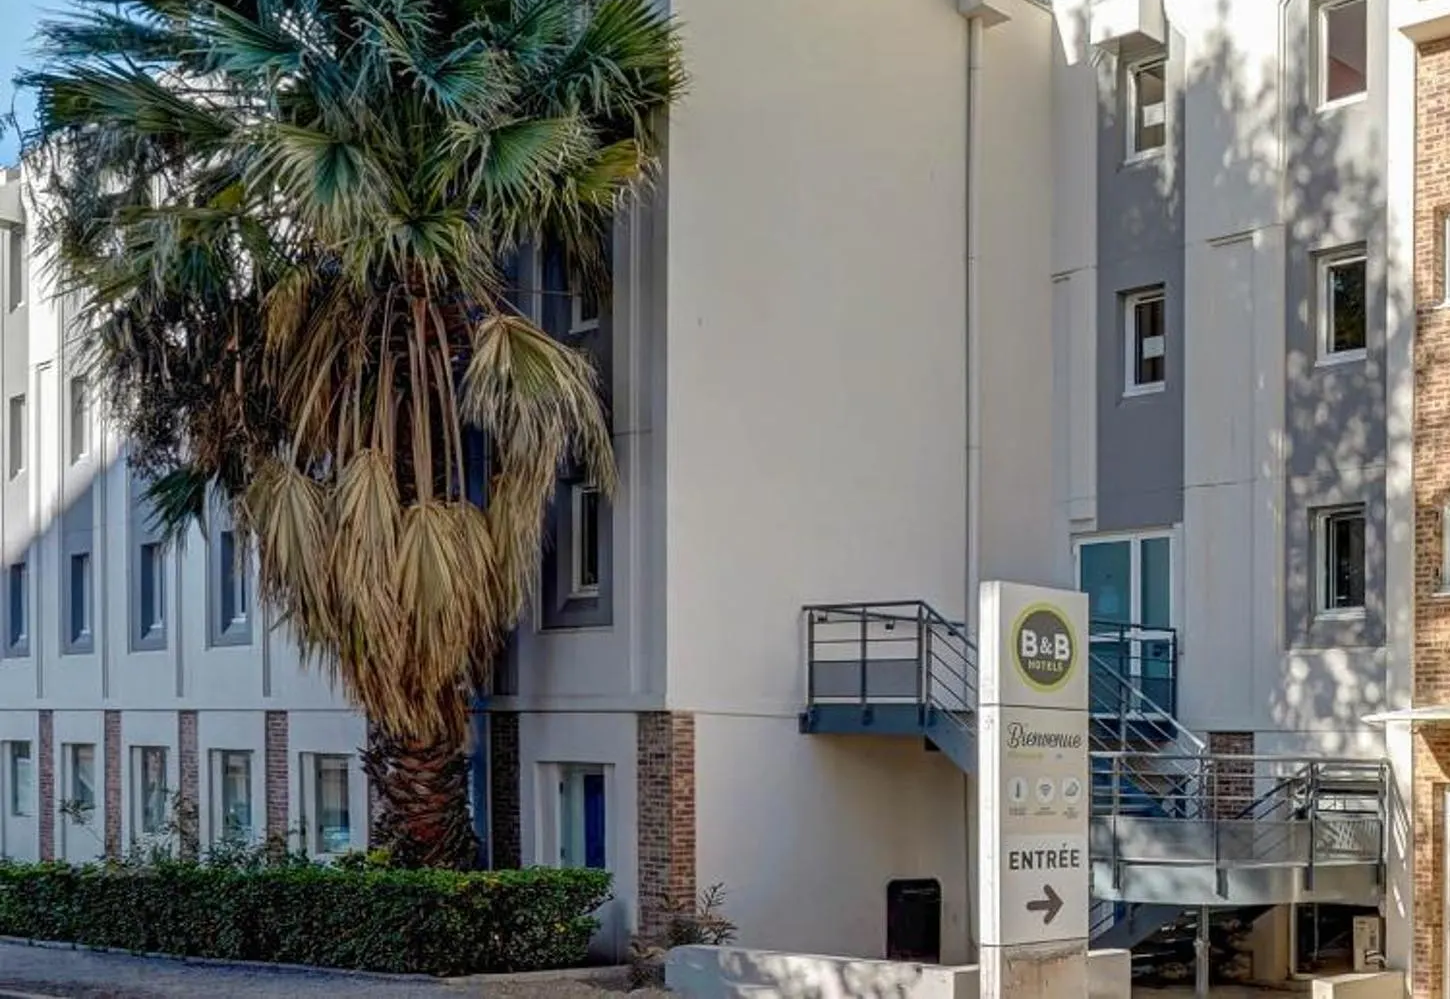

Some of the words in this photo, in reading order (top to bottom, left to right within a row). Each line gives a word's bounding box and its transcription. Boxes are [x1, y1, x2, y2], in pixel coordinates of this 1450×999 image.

[1021, 629, 1070, 660] B&B
[1027, 659, 1063, 673] HOTELS
[1006, 721, 1081, 749] Bienvenue
[1009, 842, 1080, 870] ENTRÉE
